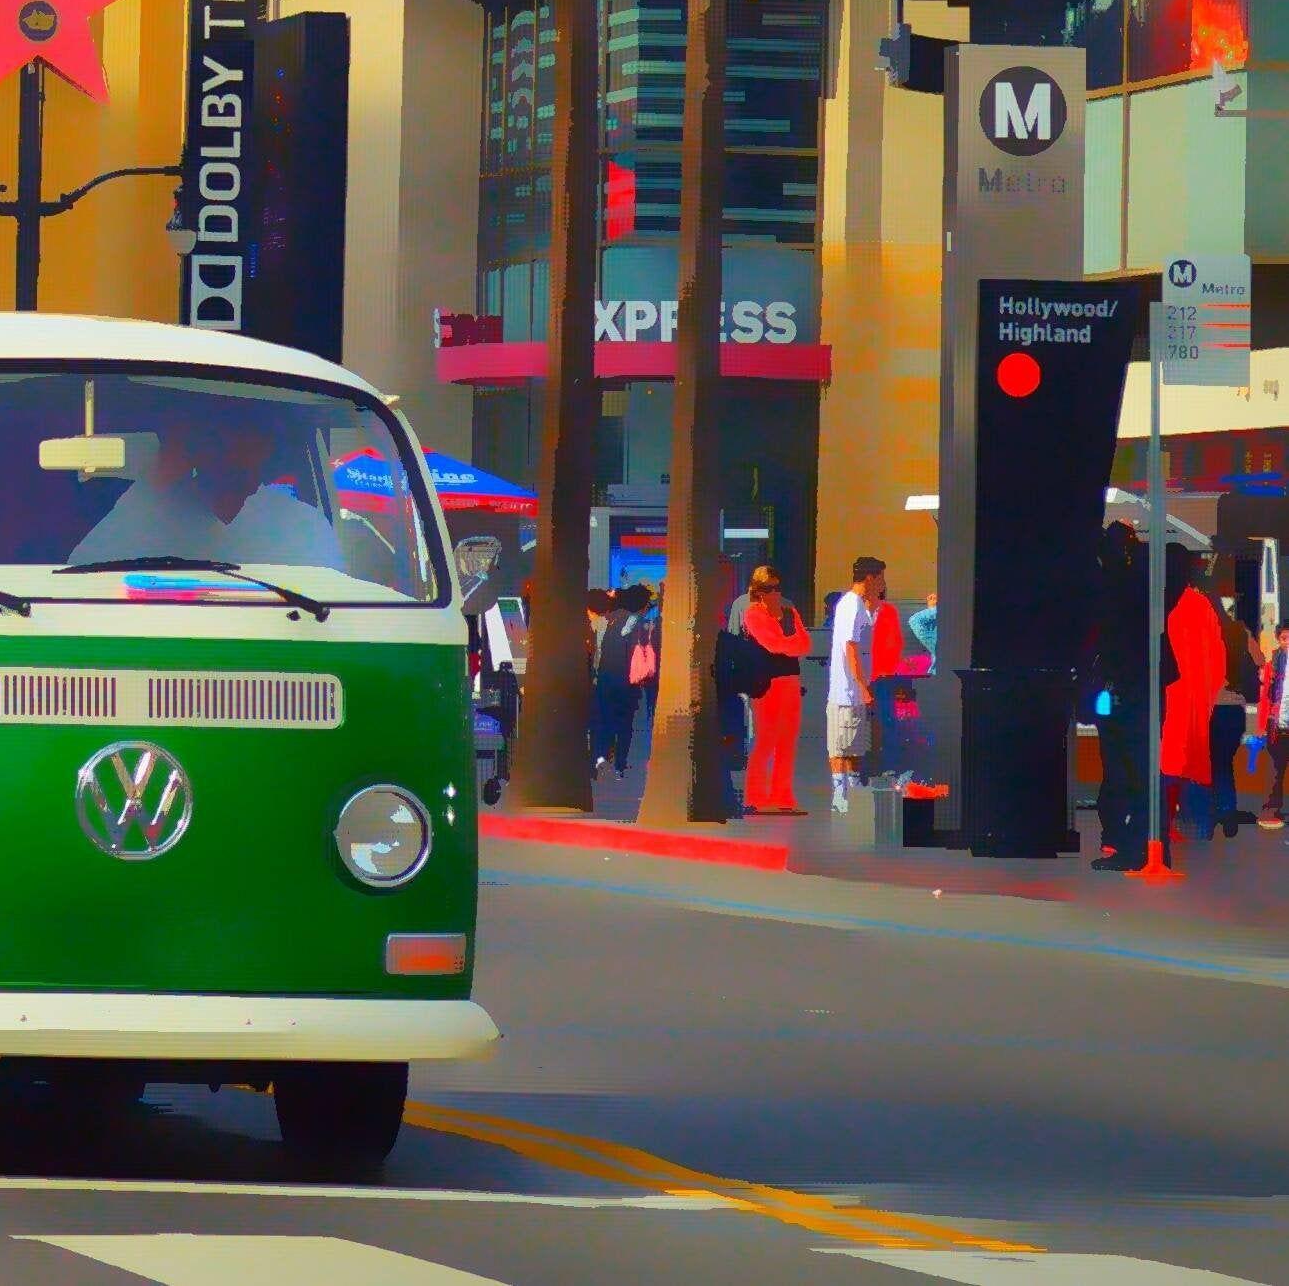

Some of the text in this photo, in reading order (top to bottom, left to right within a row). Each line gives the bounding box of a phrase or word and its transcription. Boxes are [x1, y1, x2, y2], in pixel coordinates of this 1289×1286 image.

[994, 81, 1052, 140] M
[196, 55, 244, 243] DOLBY
[999, 296, 1119, 320] Hollywood/
[1167, 305, 1197, 321] 212
[999, 322, 1092, 346] Highland
[1167, 325, 1197, 340] 217
[1167, 344, 1199, 360] 780
